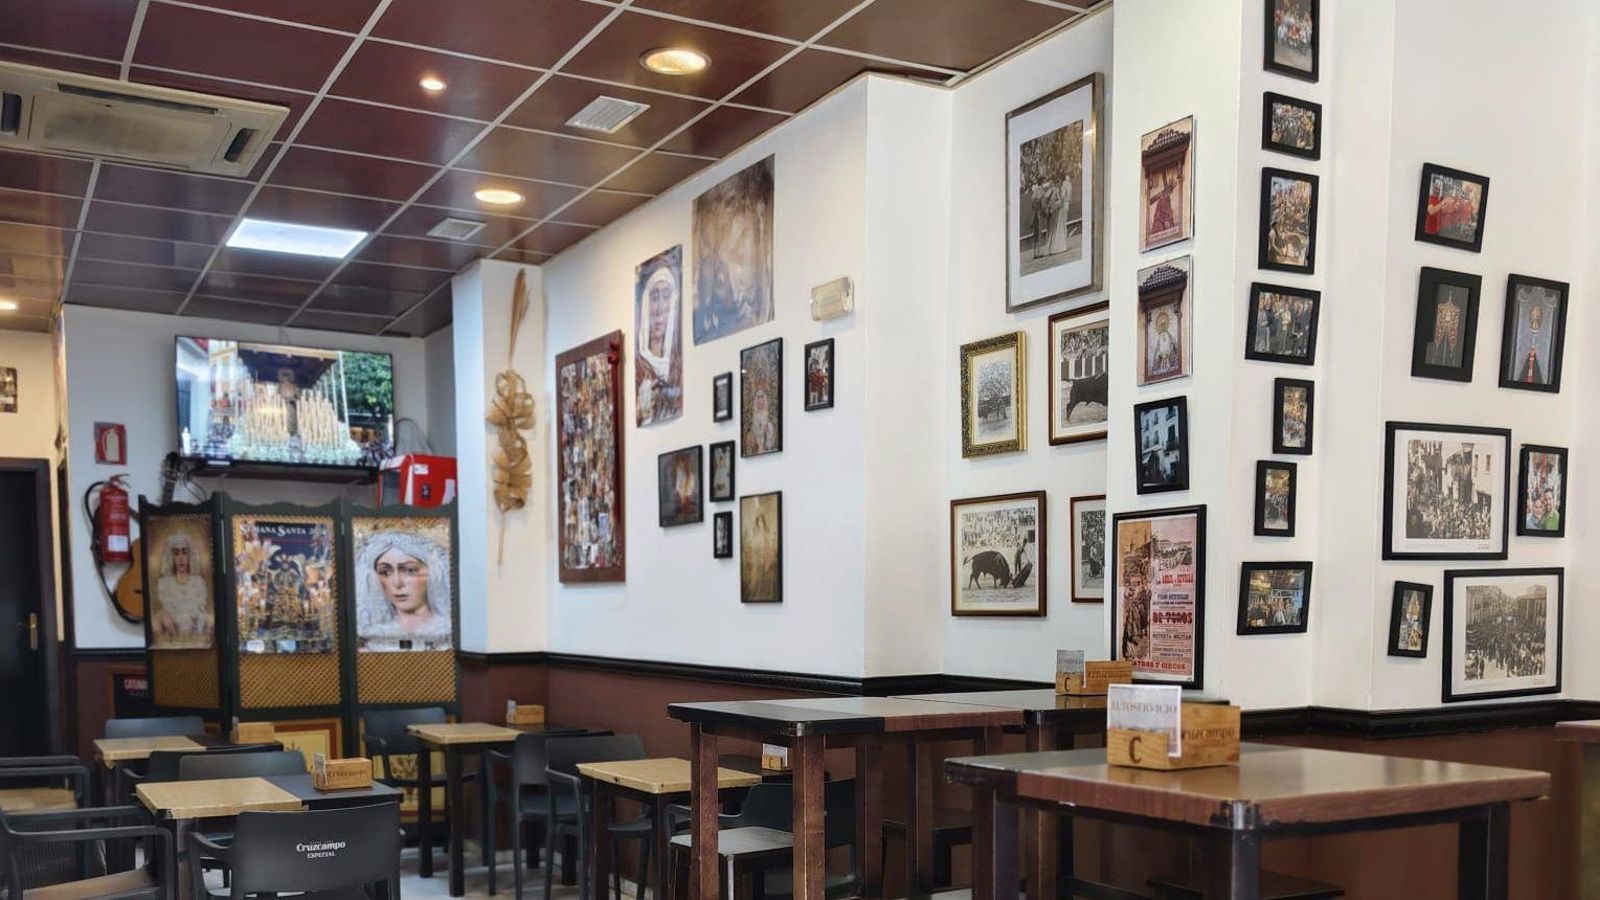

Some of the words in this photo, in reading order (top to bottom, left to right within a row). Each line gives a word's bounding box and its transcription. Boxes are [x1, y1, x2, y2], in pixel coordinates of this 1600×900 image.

[277, 525, 306, 537] SANTA
[1131, 659, 1154, 668] ATROS
[1161, 662, 1186, 670] CIRCOS
[1128, 736, 1142, 764] C
[296, 841, 346, 853] Cruzcampo
[307, 851, 335, 859] ESPECIAL
